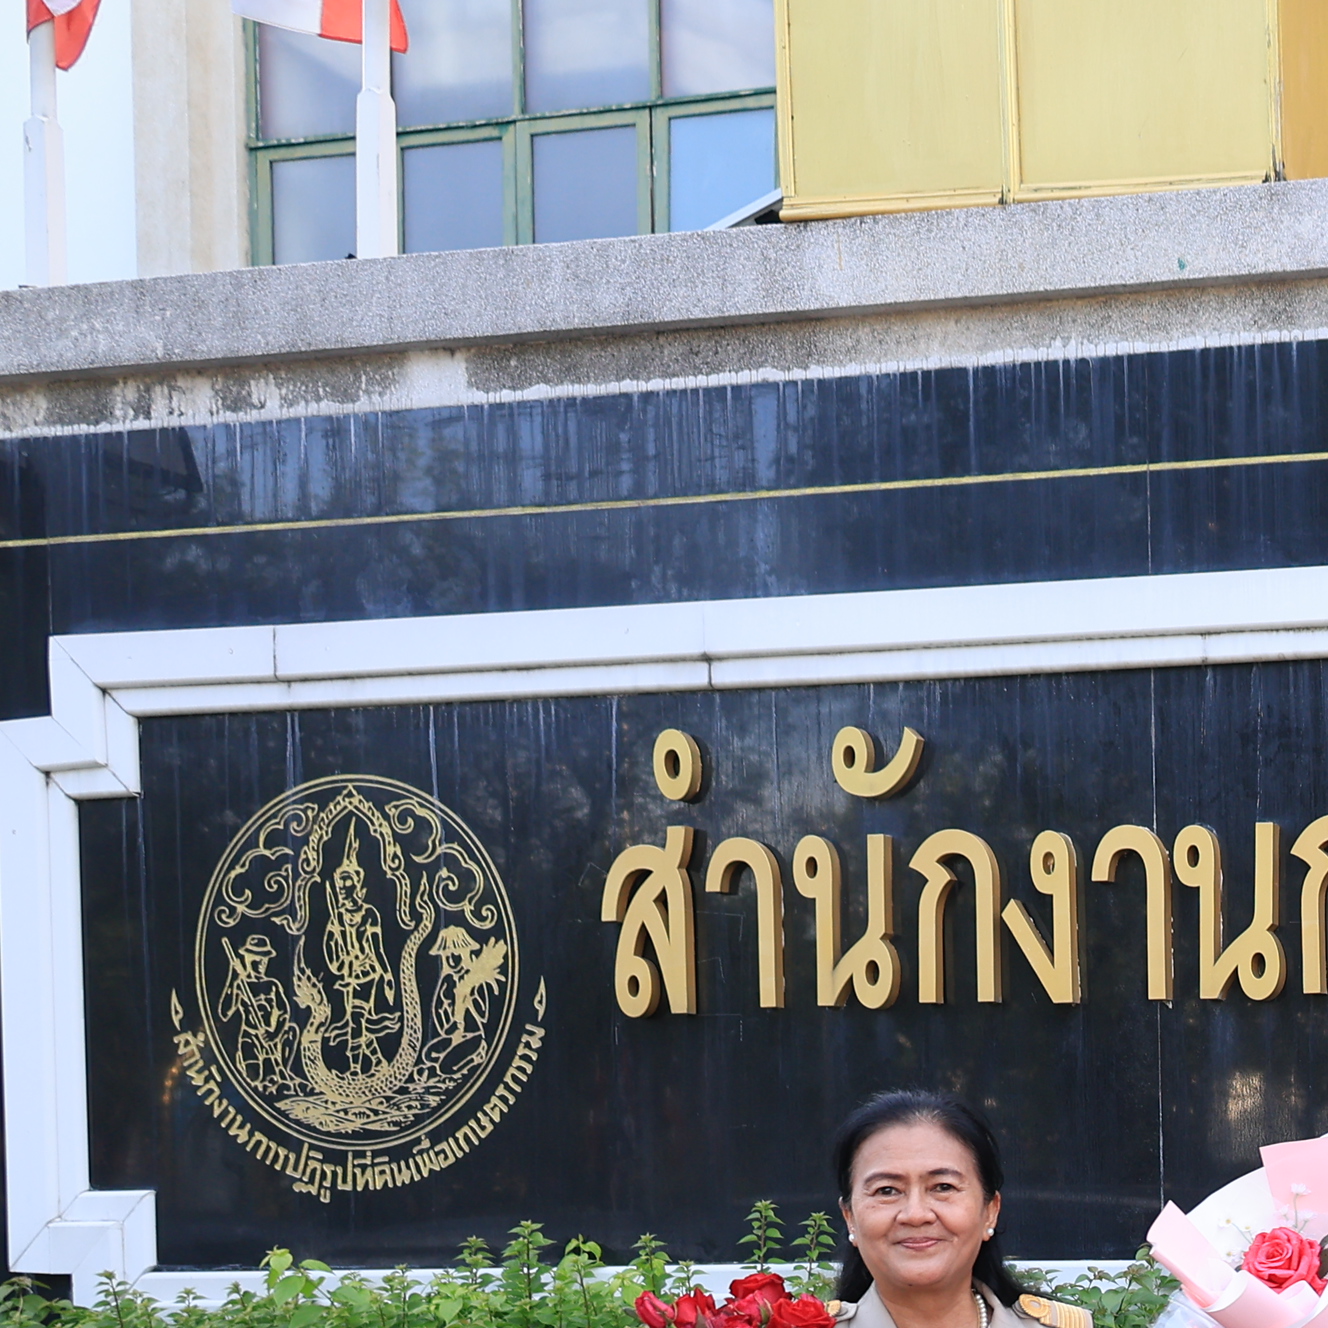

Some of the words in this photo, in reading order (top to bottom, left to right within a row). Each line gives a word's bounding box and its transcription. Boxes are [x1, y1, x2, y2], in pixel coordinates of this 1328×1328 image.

[173, 1023, 546, 1203] สำนักงานการปฏิรูปที่ดินเพื่อเกษตรกรรม
